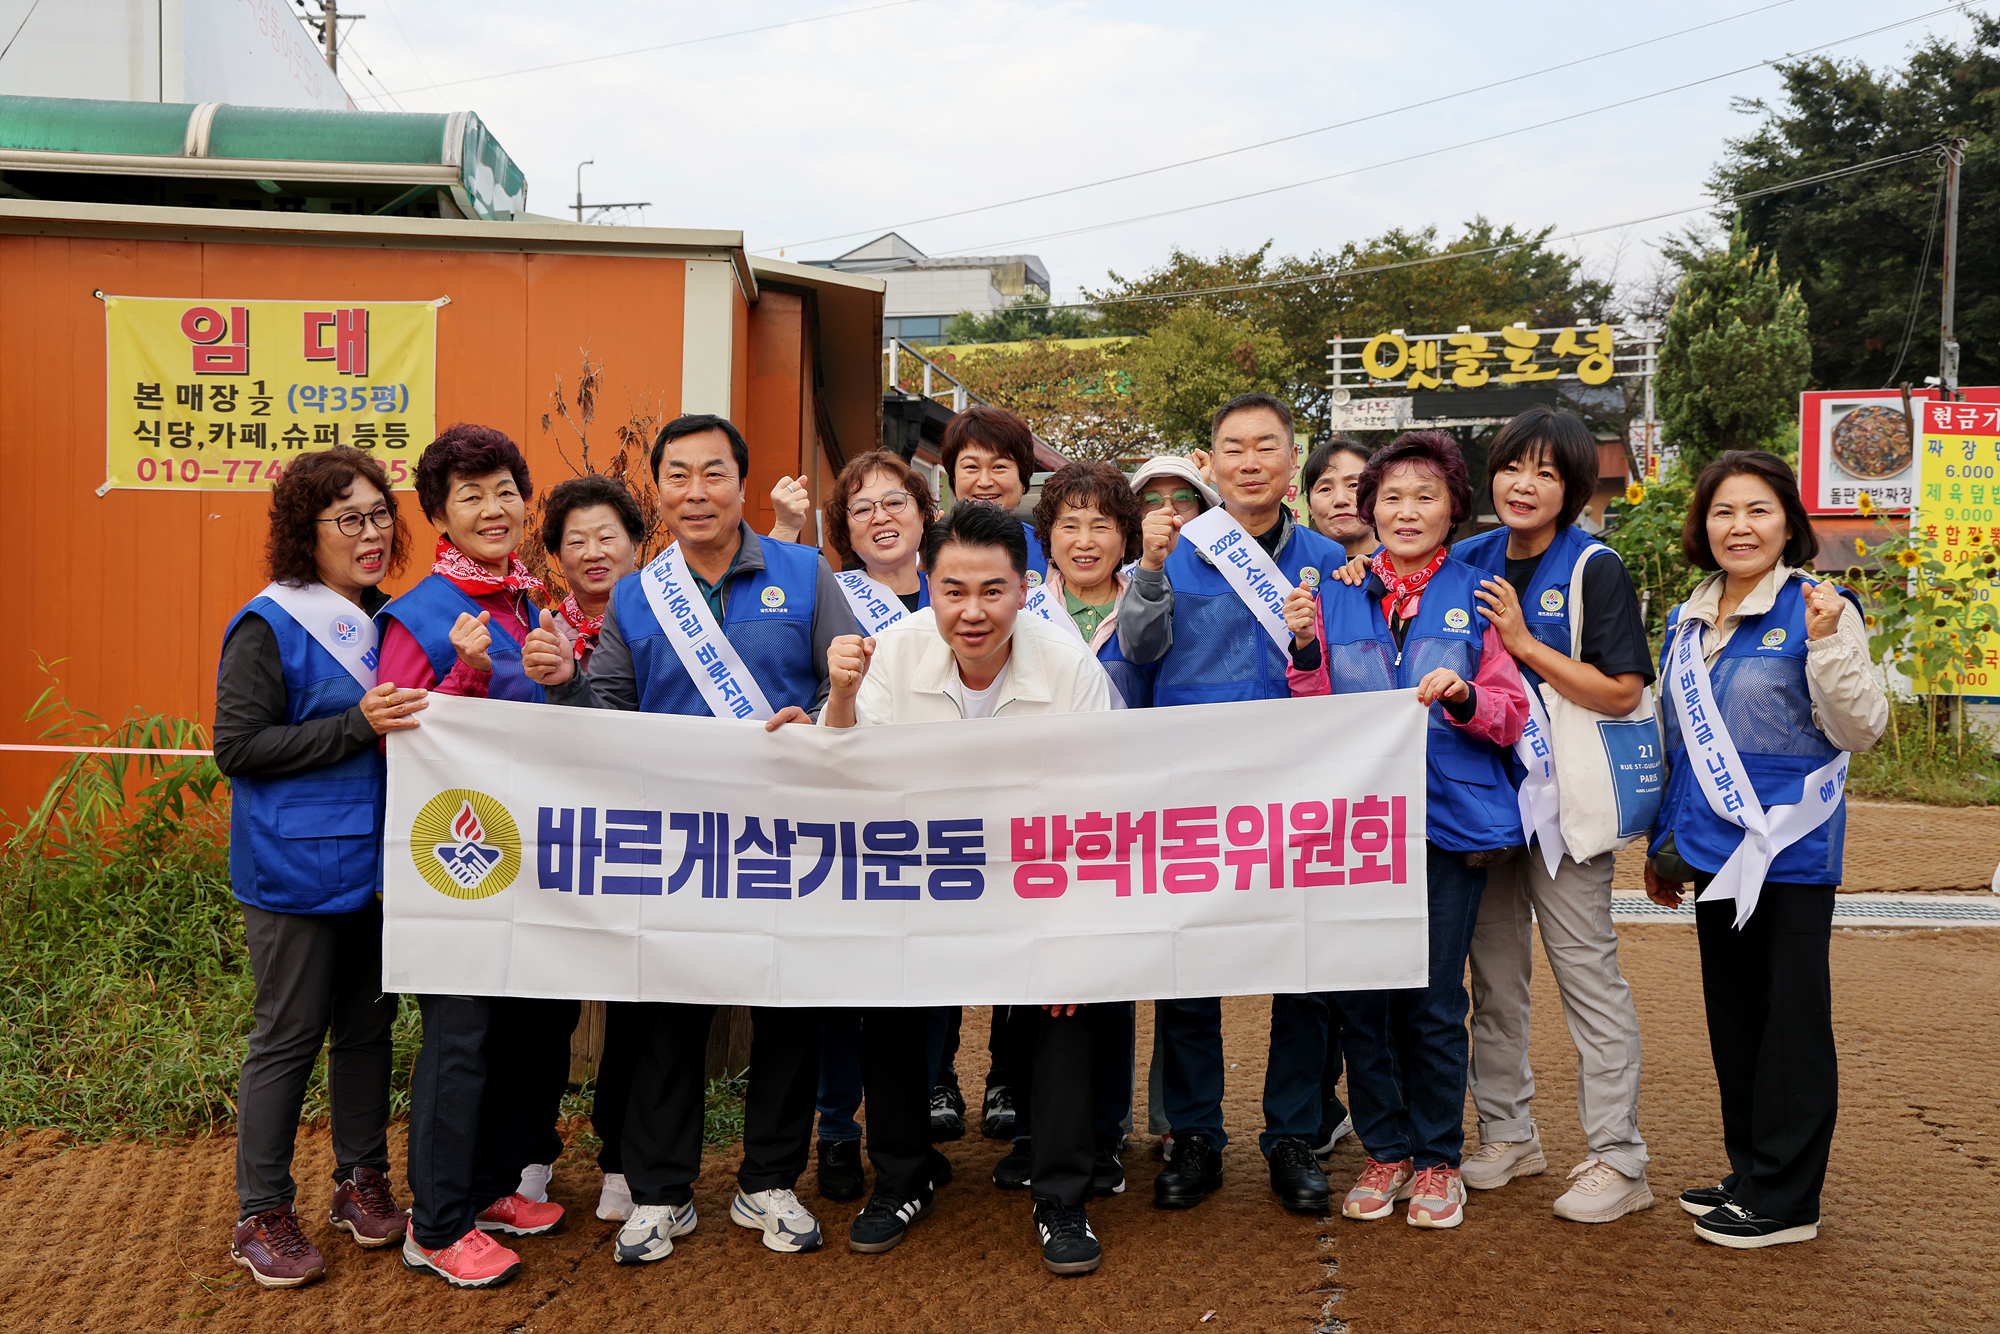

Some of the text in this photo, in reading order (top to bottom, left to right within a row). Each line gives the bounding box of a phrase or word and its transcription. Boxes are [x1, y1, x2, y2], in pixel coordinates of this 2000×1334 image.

[133, 383, 164, 410] 본
[176, 384, 239, 412] 매장
[287, 383, 409, 414] (약35평)
[351, 422, 410, 449] 등등
[1945, 464, 1994, 479] 6.000
[1944, 508, 1993, 522] 9.000
[1209, 529, 1242, 556] 2025
[1943, 549, 1991, 563] 8.0
[653, 561, 704, 639] 탄소중립
[1024, 590, 1046, 612] 025
[1638, 744, 1653, 758] 21
[1640, 774, 1658, 783] PARIS
[538, 795, 1407, 900] 바르게살기운동 방학1동위원회
